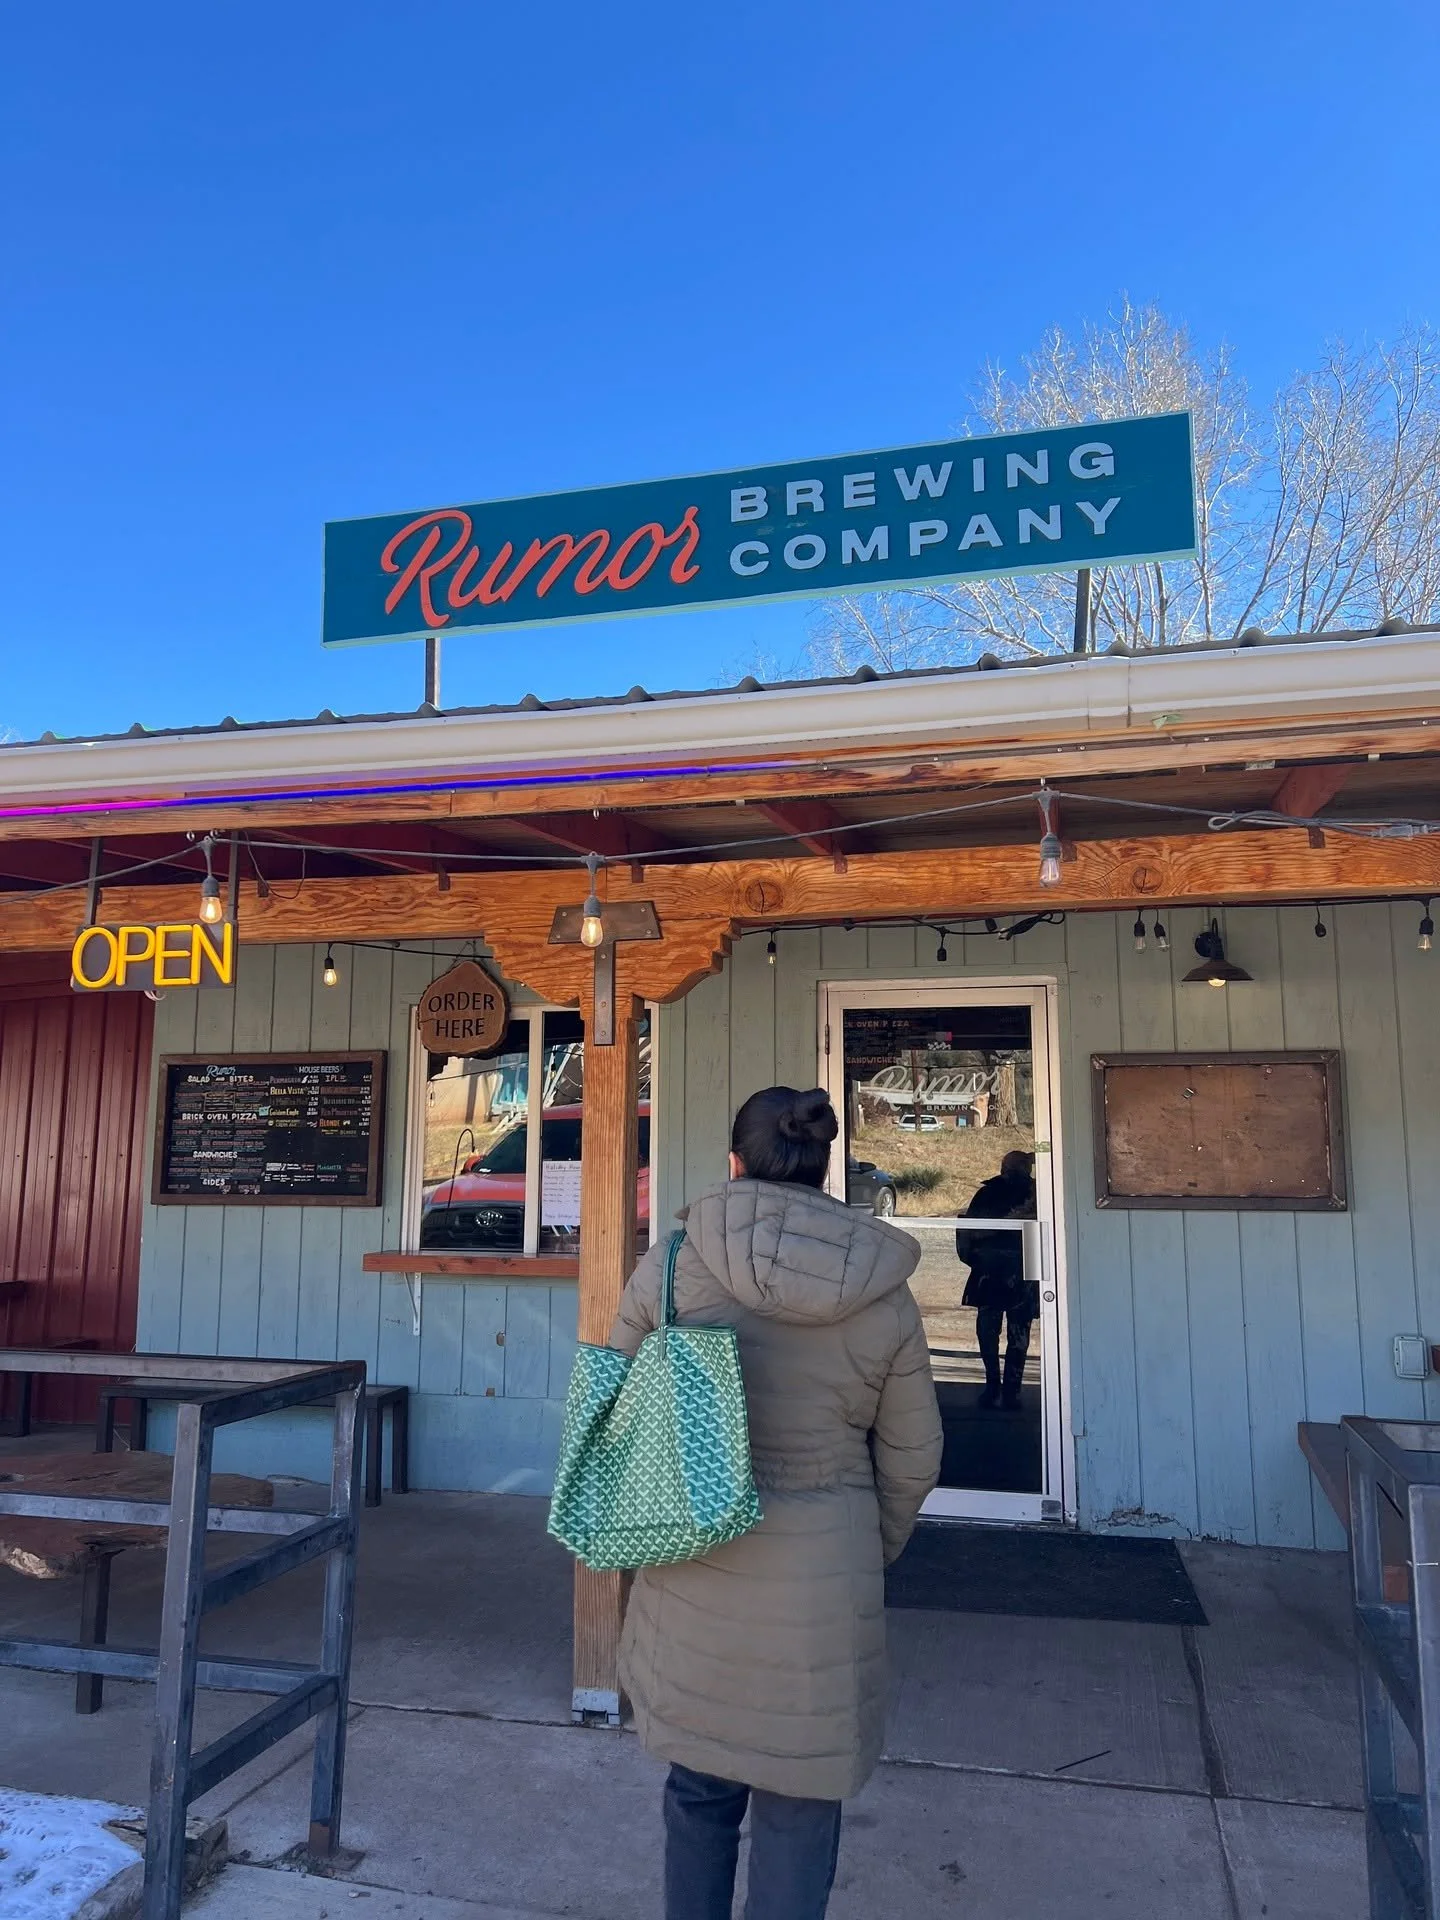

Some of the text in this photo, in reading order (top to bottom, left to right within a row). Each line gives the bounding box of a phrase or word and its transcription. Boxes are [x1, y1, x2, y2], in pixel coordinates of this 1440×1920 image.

[730, 442, 1115, 523] BREWING
[729, 497, 1121, 576] COMPANY
[380, 509, 700, 627] Rumor
[71, 922, 232, 989] OPEN
[428, 991, 495, 1012] ORDER
[436, 1017, 485, 1038] HERE
[187, 1075, 210, 1083] SALAD
[229, 1075, 254, 1083] BITES
[870, 1065, 1000, 1111] Rumor
